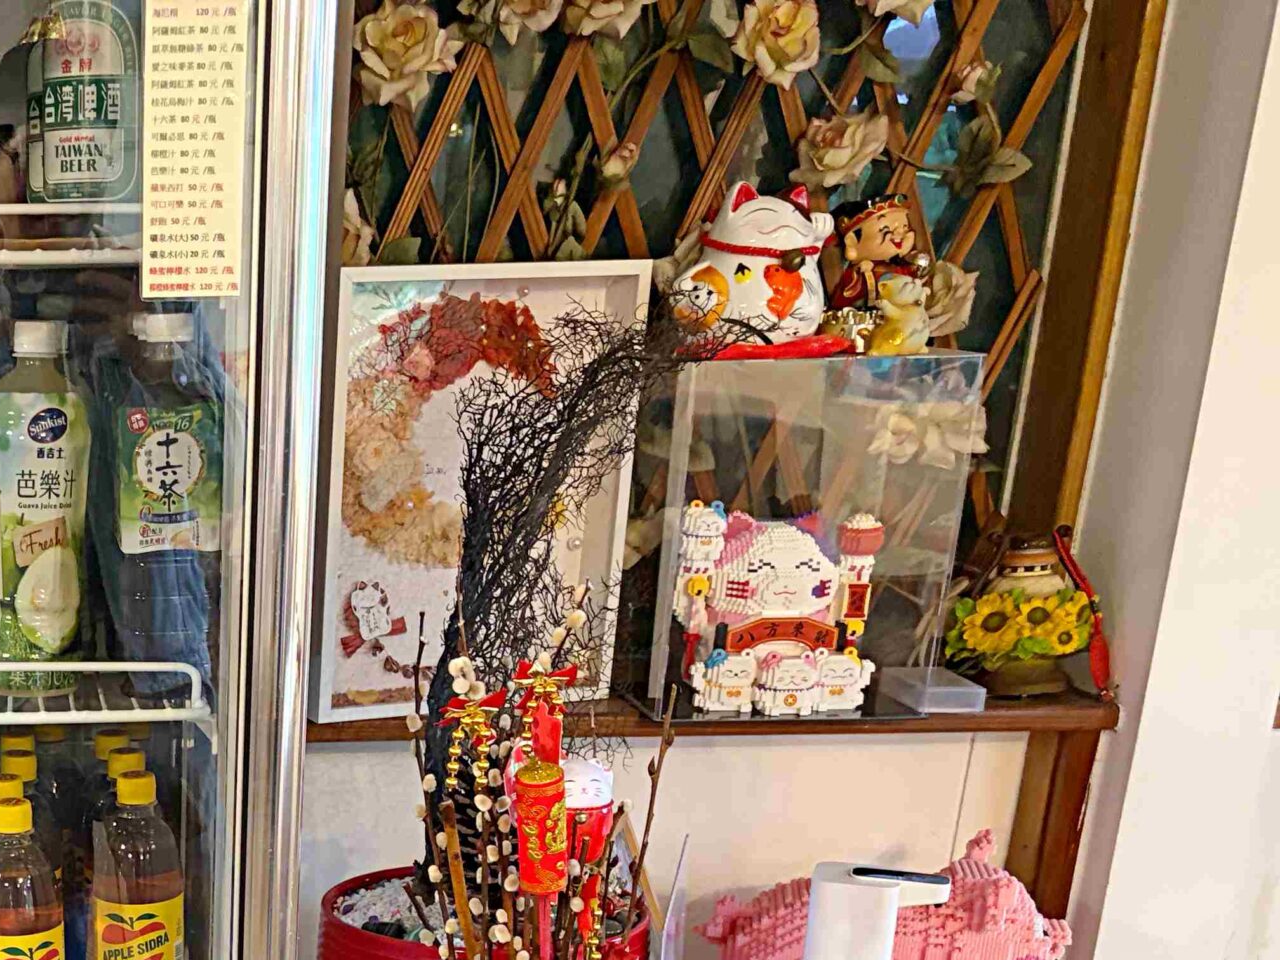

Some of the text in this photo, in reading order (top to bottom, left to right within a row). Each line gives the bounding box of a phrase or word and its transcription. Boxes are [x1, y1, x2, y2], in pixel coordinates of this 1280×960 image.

[54, 144, 103, 159] TAIWAN
[60, 159, 98, 173] BEER
[29, 415, 66, 436] Sunkist
[176, 418, 190, 430] 16
[155, 433, 185, 512] 十六茶
[16, 469, 76, 499] 芭樂汁
[40, 502, 57, 510] Juice
[137, 931, 169, 955] SIDRA
